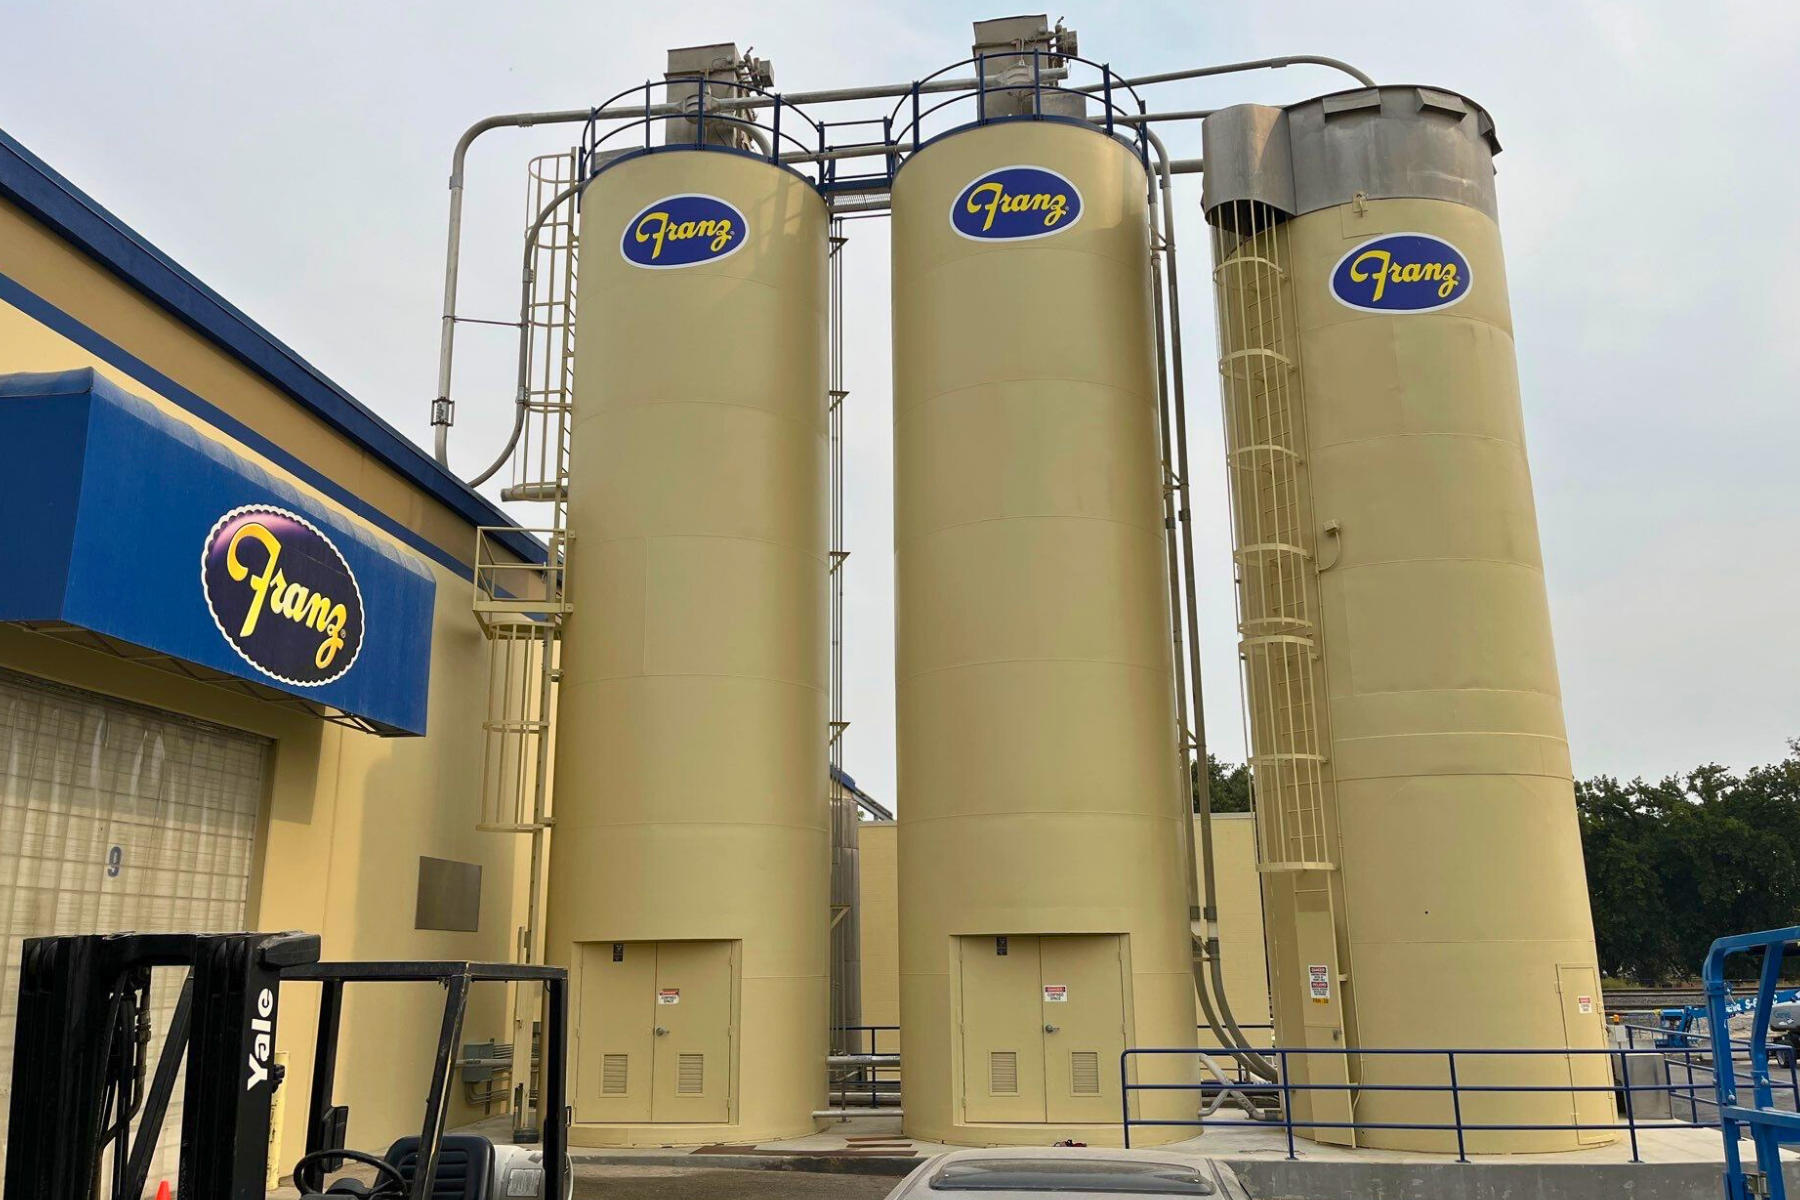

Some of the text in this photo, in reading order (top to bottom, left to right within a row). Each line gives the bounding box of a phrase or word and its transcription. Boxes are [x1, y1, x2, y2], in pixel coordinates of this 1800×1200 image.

[967, 182, 1067, 232] Franz
[636, 212, 732, 260] Franz
[1350, 250, 1459, 302] Franz
[227, 522, 347, 669] Franz
[107, 846, 121, 877] 9
[247, 988, 274, 1091] Yale
